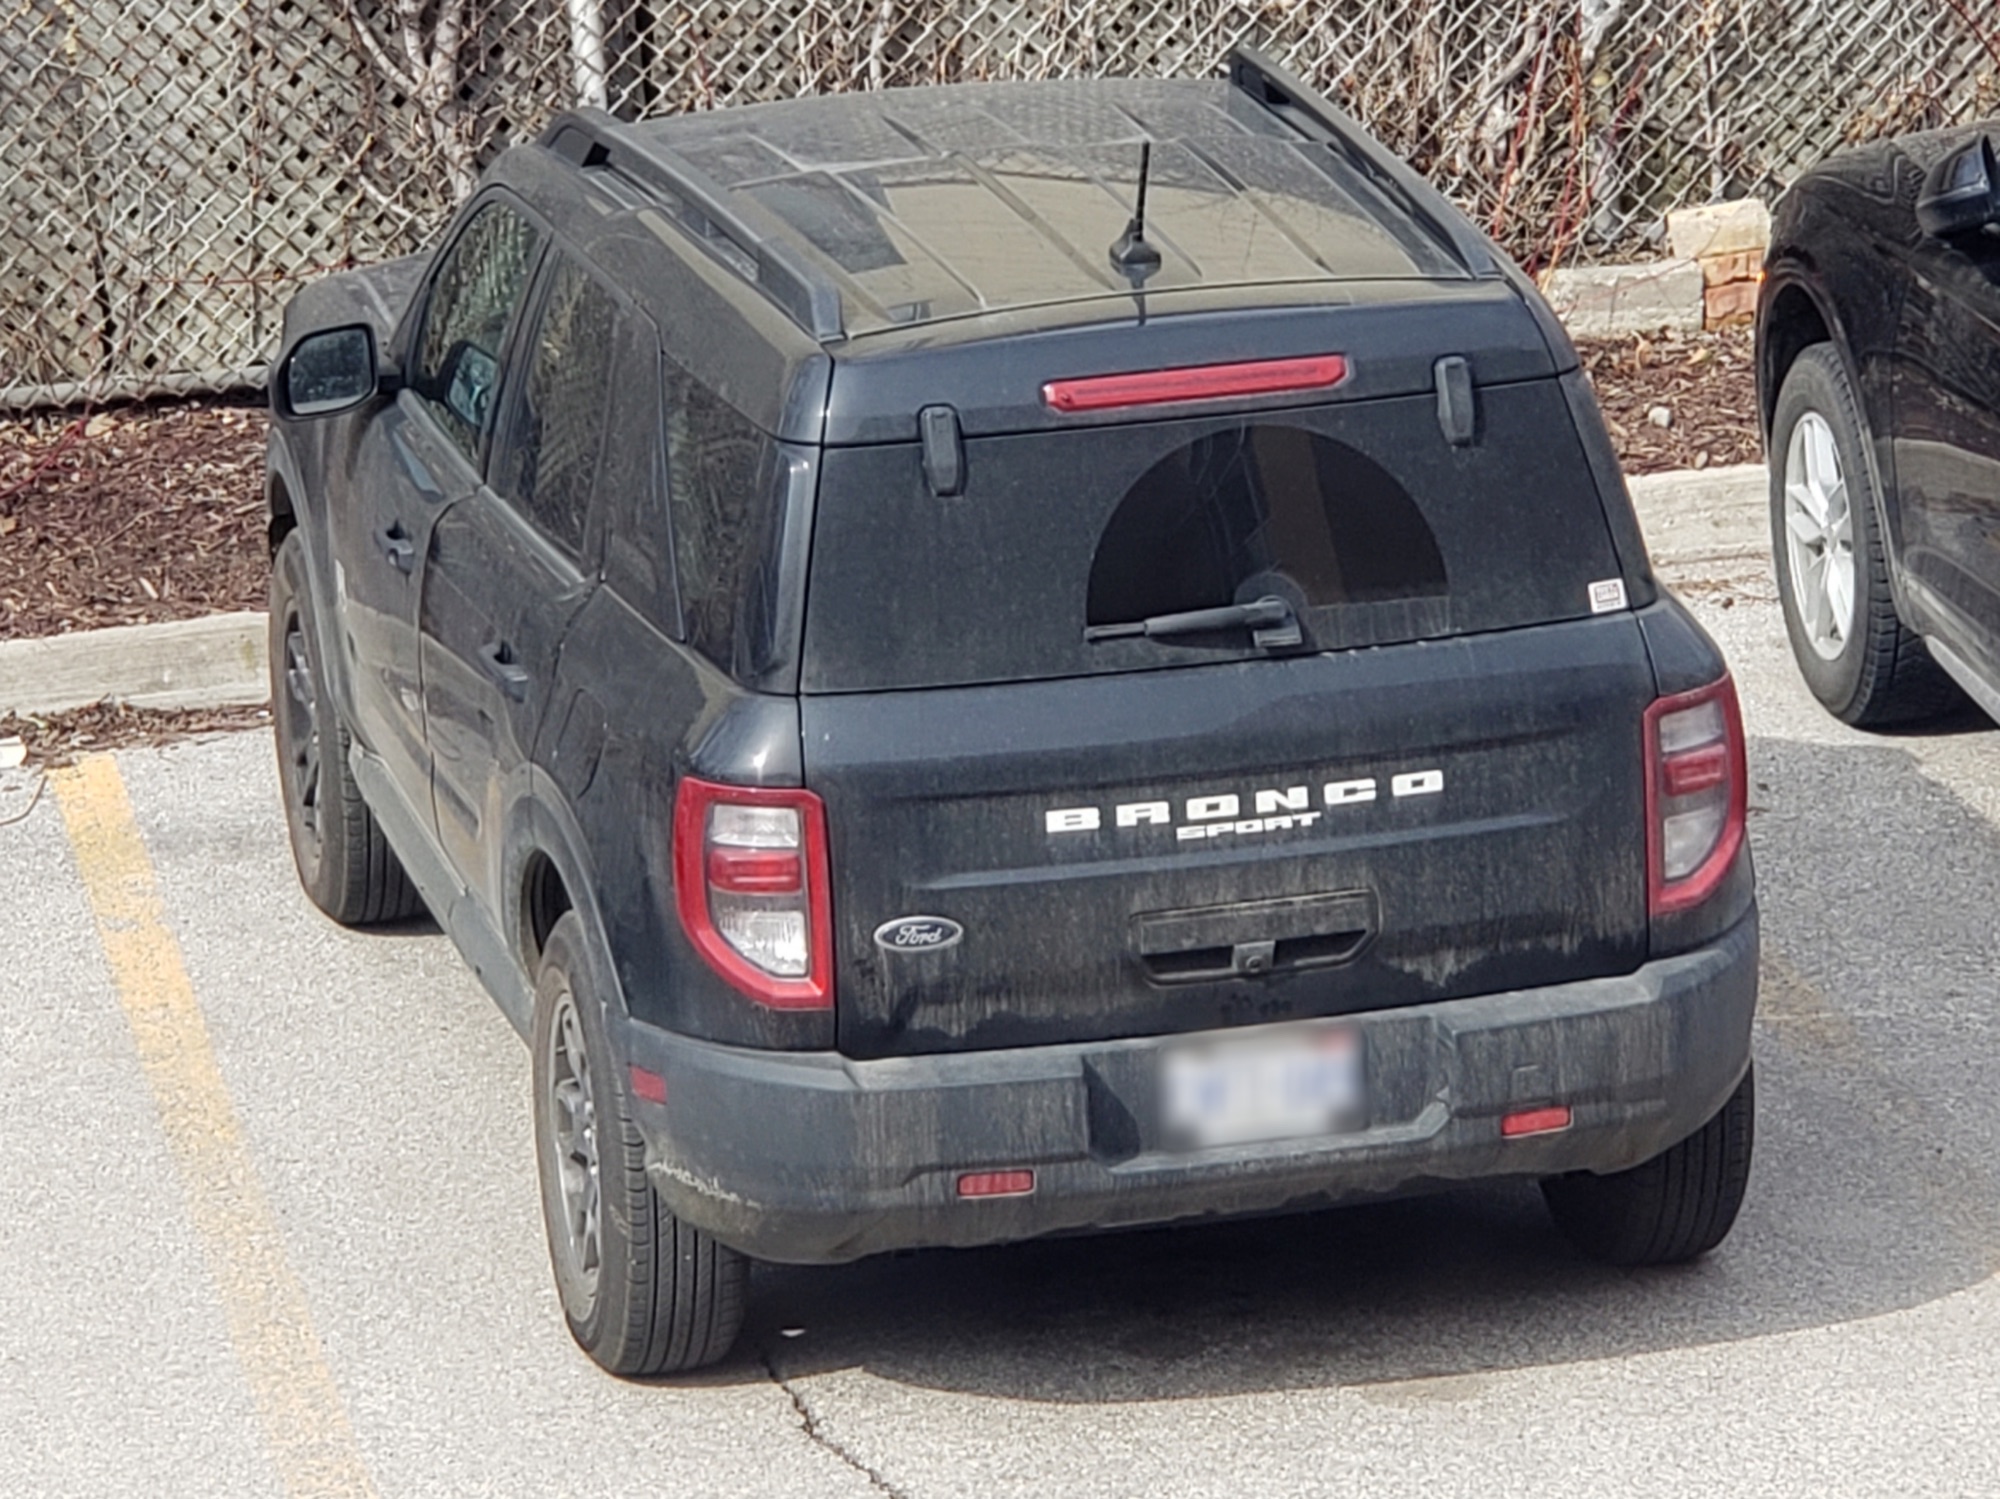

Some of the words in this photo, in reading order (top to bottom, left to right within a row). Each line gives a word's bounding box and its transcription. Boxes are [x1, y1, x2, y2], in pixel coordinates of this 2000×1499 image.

[1045, 770, 1444, 833] BRONCO
[1176, 811, 1322, 840] SPORT
[895, 924, 942, 945] Ford
